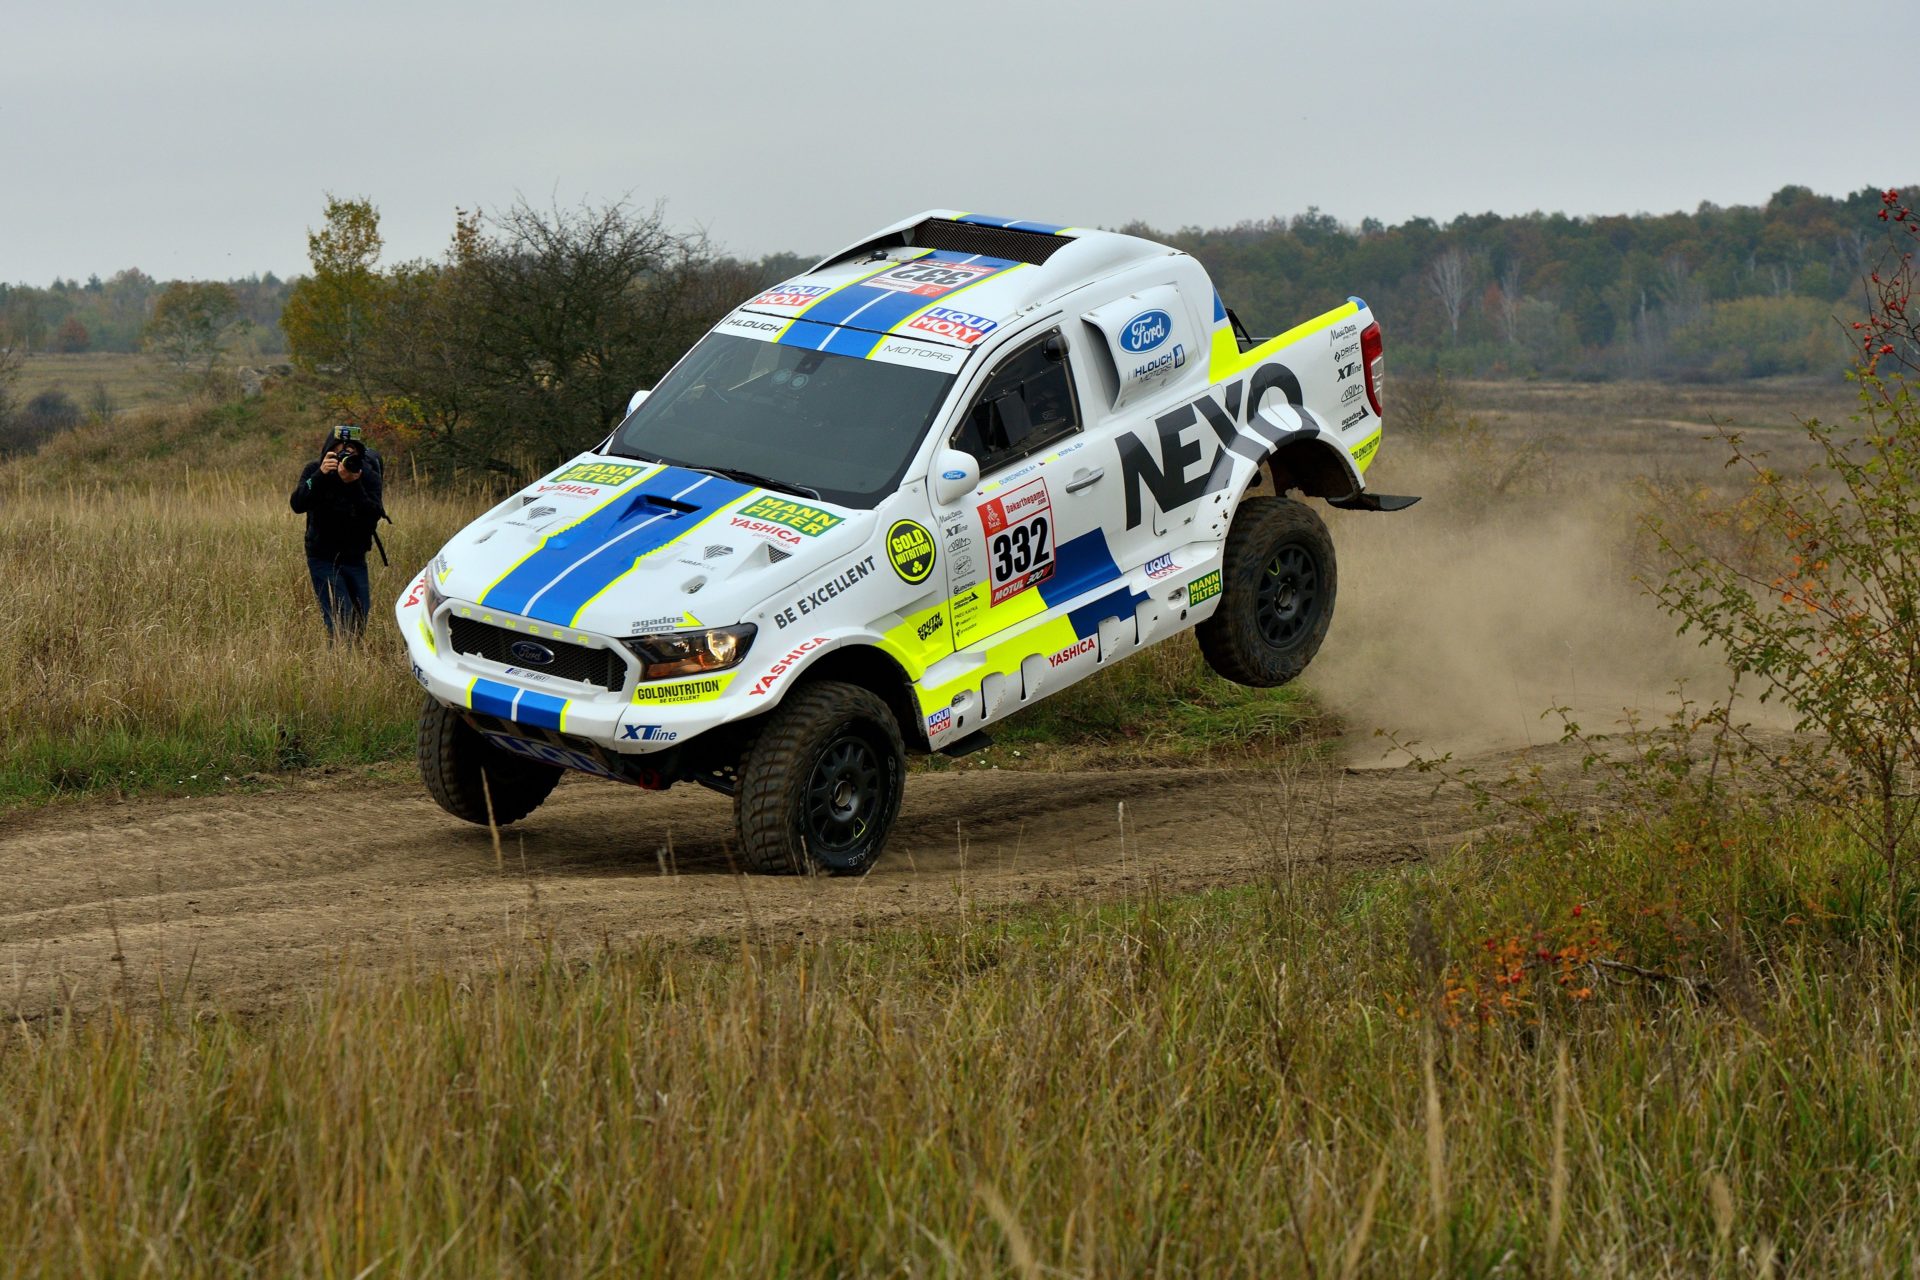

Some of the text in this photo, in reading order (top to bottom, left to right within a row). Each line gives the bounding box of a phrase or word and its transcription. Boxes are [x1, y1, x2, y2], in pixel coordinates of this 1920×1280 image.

[891, 264, 974, 286] 332
[756, 294, 814, 306] MOLY
[727, 318, 784, 333] HLOUCH
[912, 316, 982, 341] MOLY
[929, 307, 996, 331] LIQUI
[1131, 316, 1165, 350] Ford
[883, 345, 954, 362] MOTORS
[1134, 352, 1173, 378] HLOUCH
[555, 471, 627, 485] FILTER
[569, 463, 641, 477] MANN
[744, 505, 824, 535] FILTER
[759, 497, 838, 527] MANN
[729, 517, 802, 545] YASHICA
[891, 528, 925, 553] GOLD
[895, 541, 931, 566] NUTRITION
[993, 516, 1050, 582] 332
[1145, 554, 1172, 575] LIQUI
[773, 555, 877, 630] BE EXCELLENT
[994, 578, 1025, 602] MOTUL
[1190, 572, 1219, 594] MANN
[1191, 582, 1221, 605] FILTER
[461, 607, 589, 645] RANGER
[631, 616, 684, 628] agados
[917, 611, 940, 636] SOUTH
[519, 644, 543, 661] Ford
[1049, 638, 1096, 669] YASHICA
[749, 636, 832, 698] YASHICA
[637, 680, 720, 700] GOLDNUTRITION
[669, 695, 700, 703] EXCELLENT
[928, 708, 950, 726] LIQUI
[930, 719, 950, 736] MOLY
[620, 724, 678, 741] XTline
